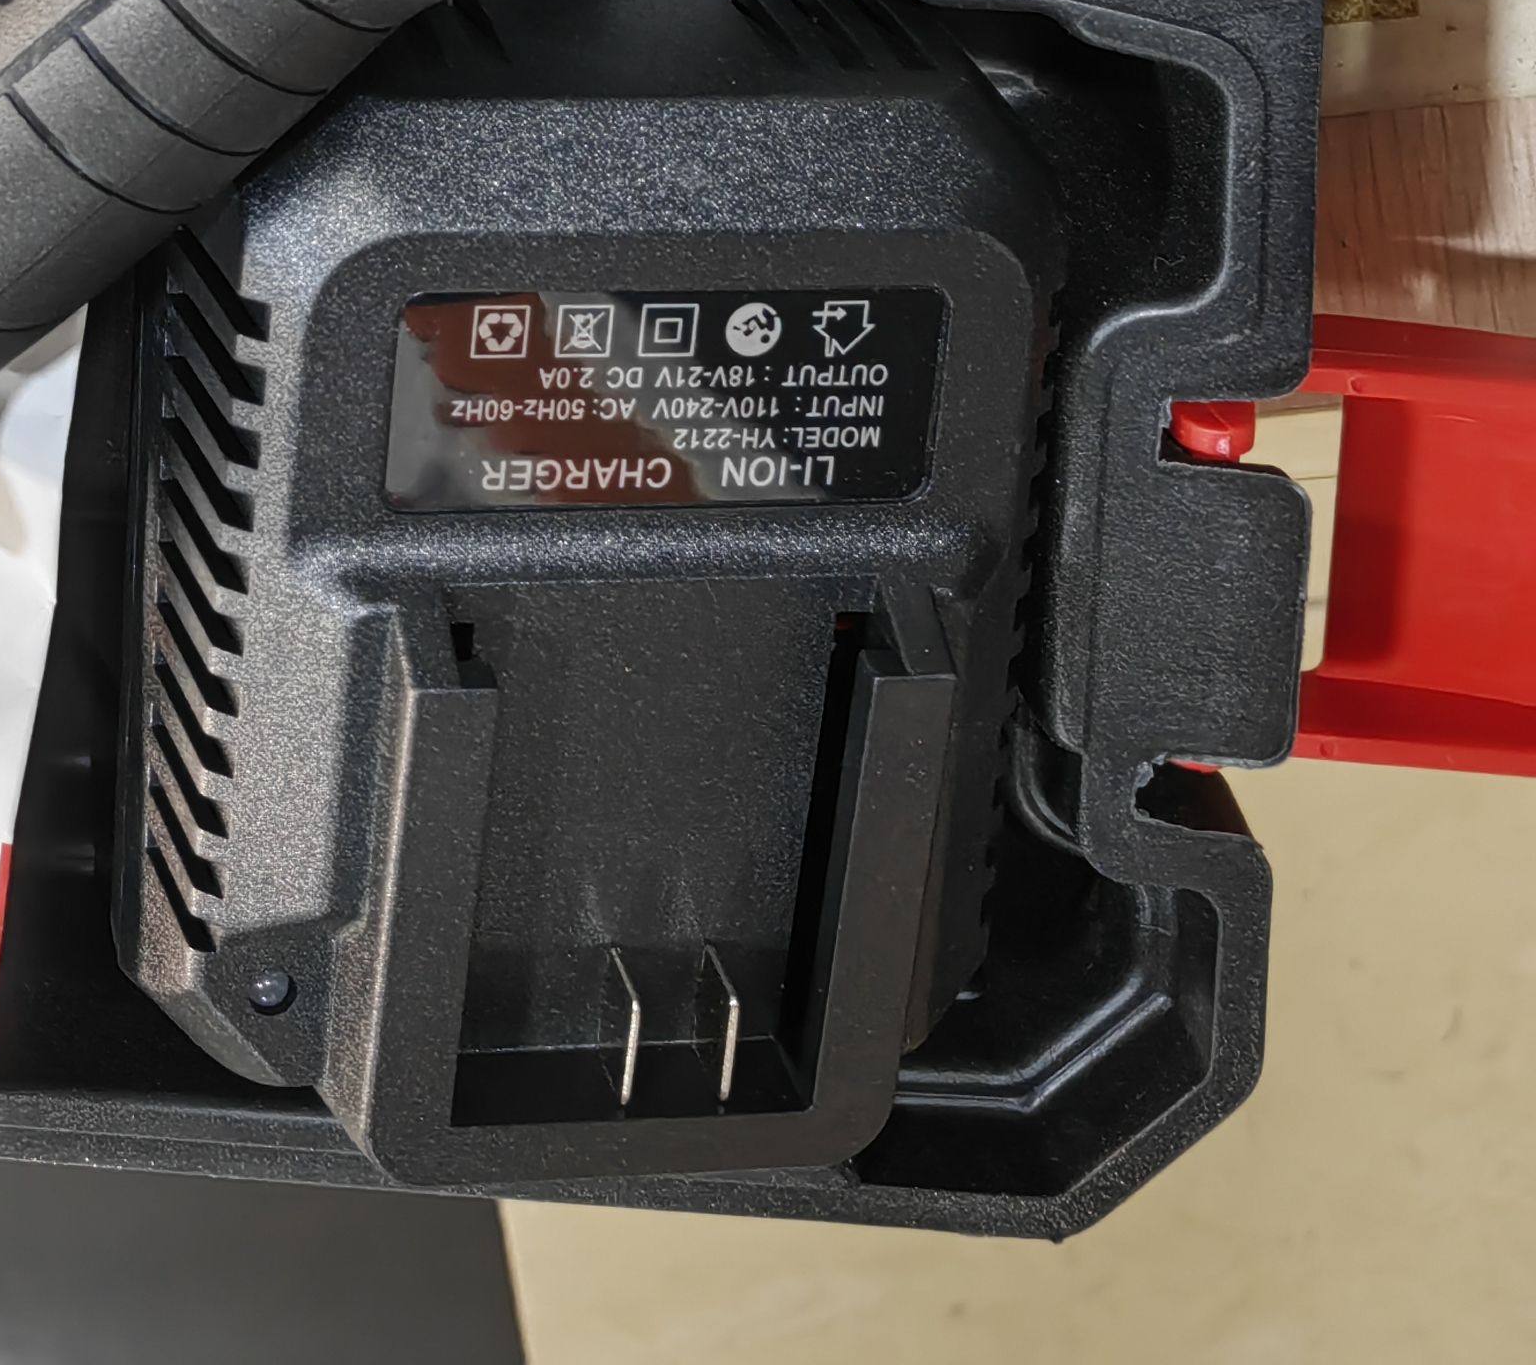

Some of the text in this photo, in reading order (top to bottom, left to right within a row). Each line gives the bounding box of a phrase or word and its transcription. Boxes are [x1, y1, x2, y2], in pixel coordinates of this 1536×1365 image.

[539, 366, 593, 387] 2.0A
[606, 366, 642, 387] DC
[656, 366, 755, 387] 18V-21V
[450, 398, 586, 420] 50Hz-60Hz
[592, 398, 636, 417] AC:
[653, 396, 780, 419] 110V-240V
[673, 426, 881, 448] MODEL: YH-2212
[481, 455, 835, 489] LI-ION CHARGER
